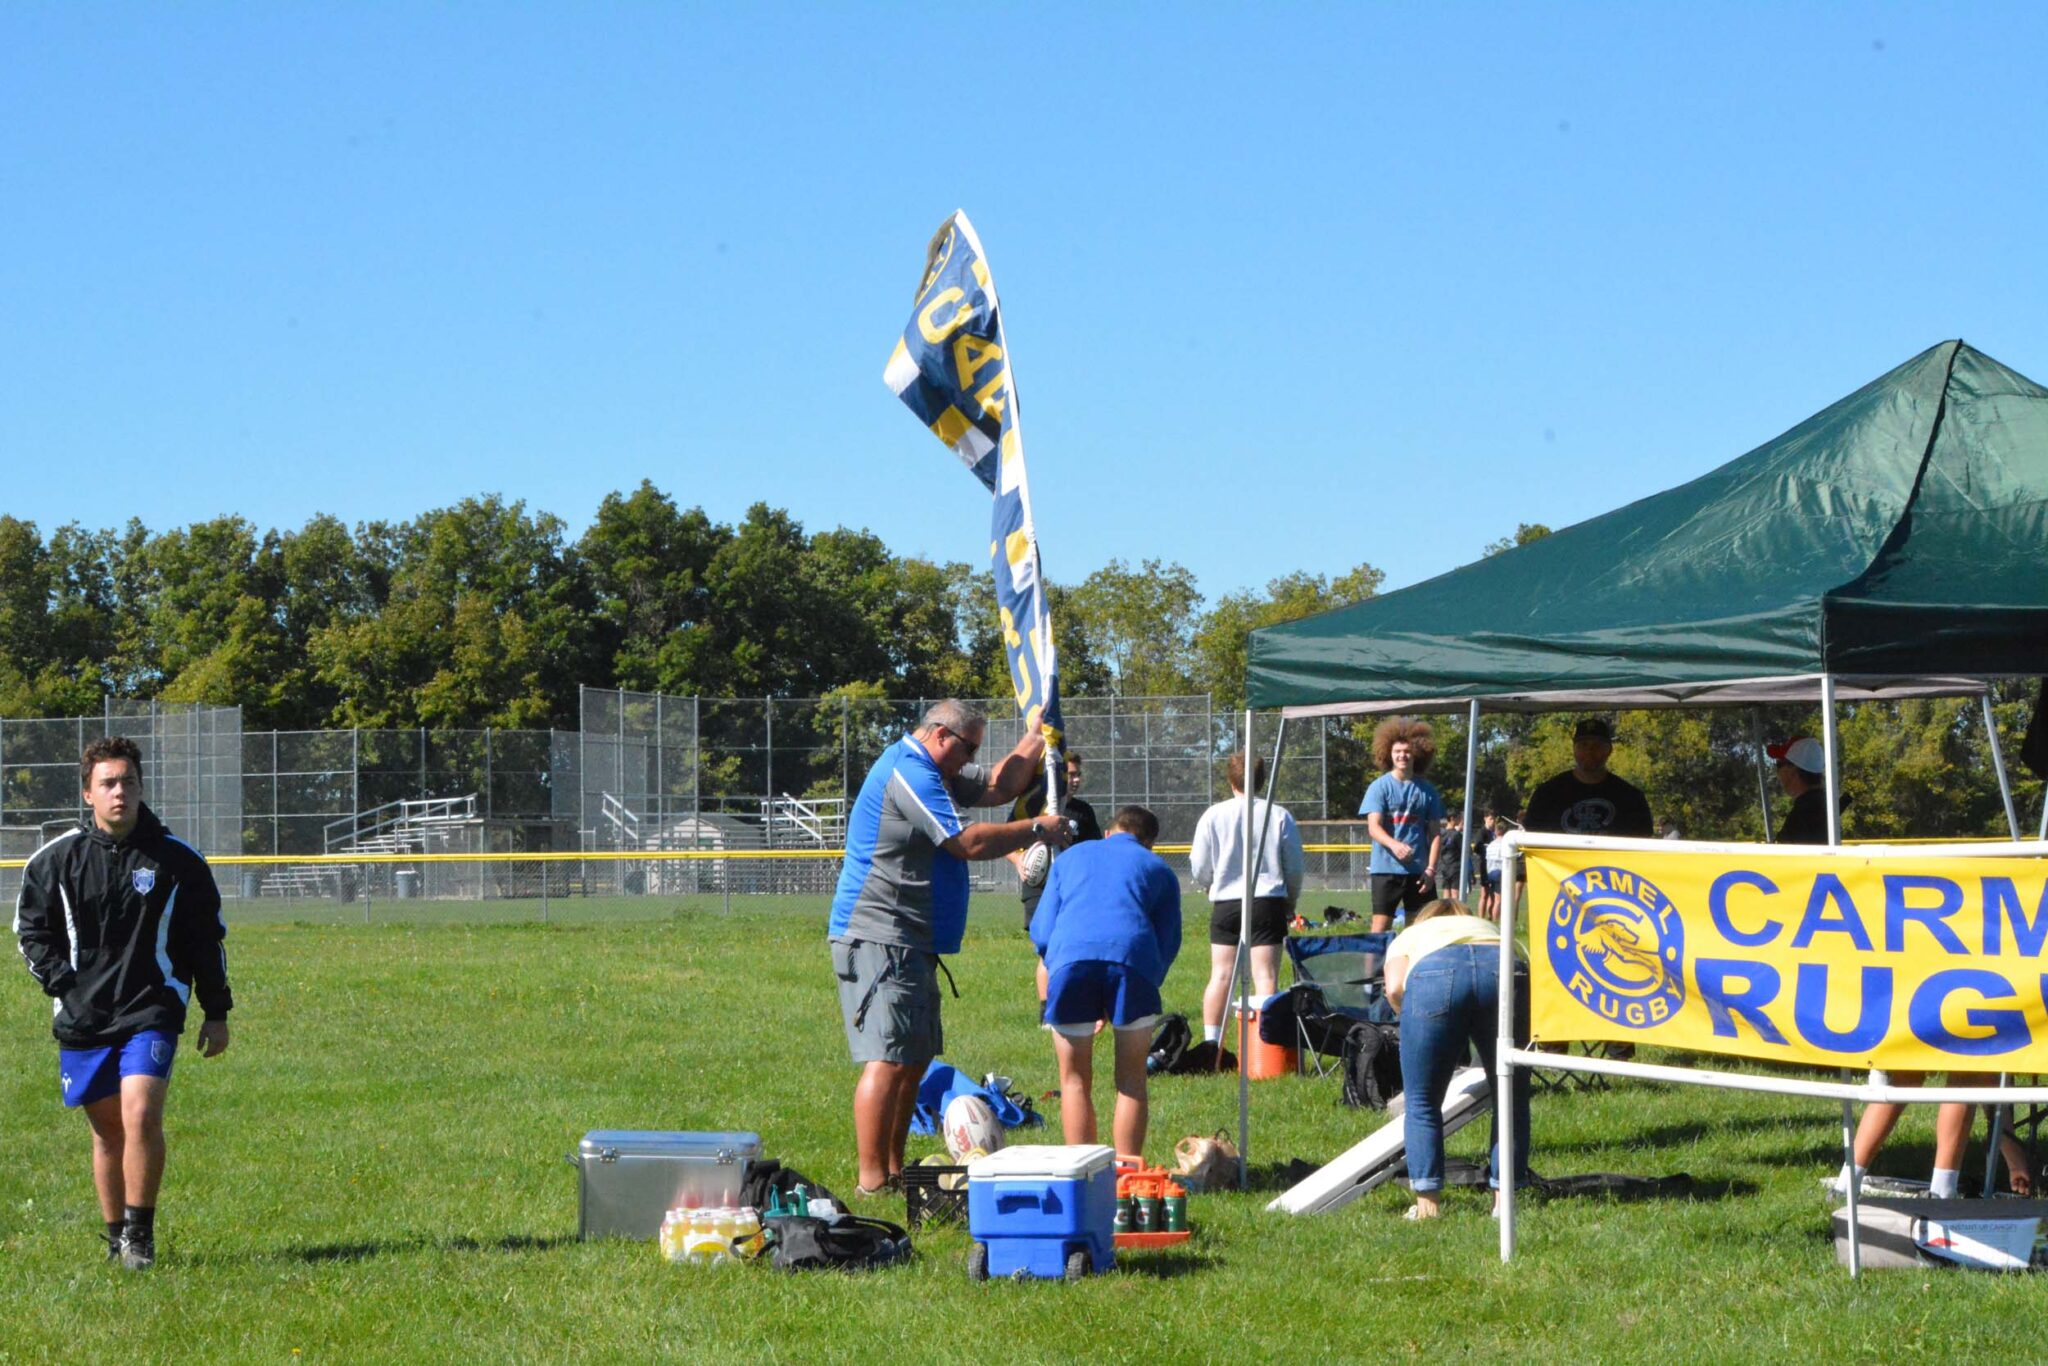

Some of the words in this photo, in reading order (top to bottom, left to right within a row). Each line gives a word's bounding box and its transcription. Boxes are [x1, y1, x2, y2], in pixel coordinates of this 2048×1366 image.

[1554, 870, 1673, 936] CARMEL
[1708, 869, 2048, 957] CARM
[1568, 970, 1682, 1026] RUGBY
[1694, 957, 2048, 1056] RUG
